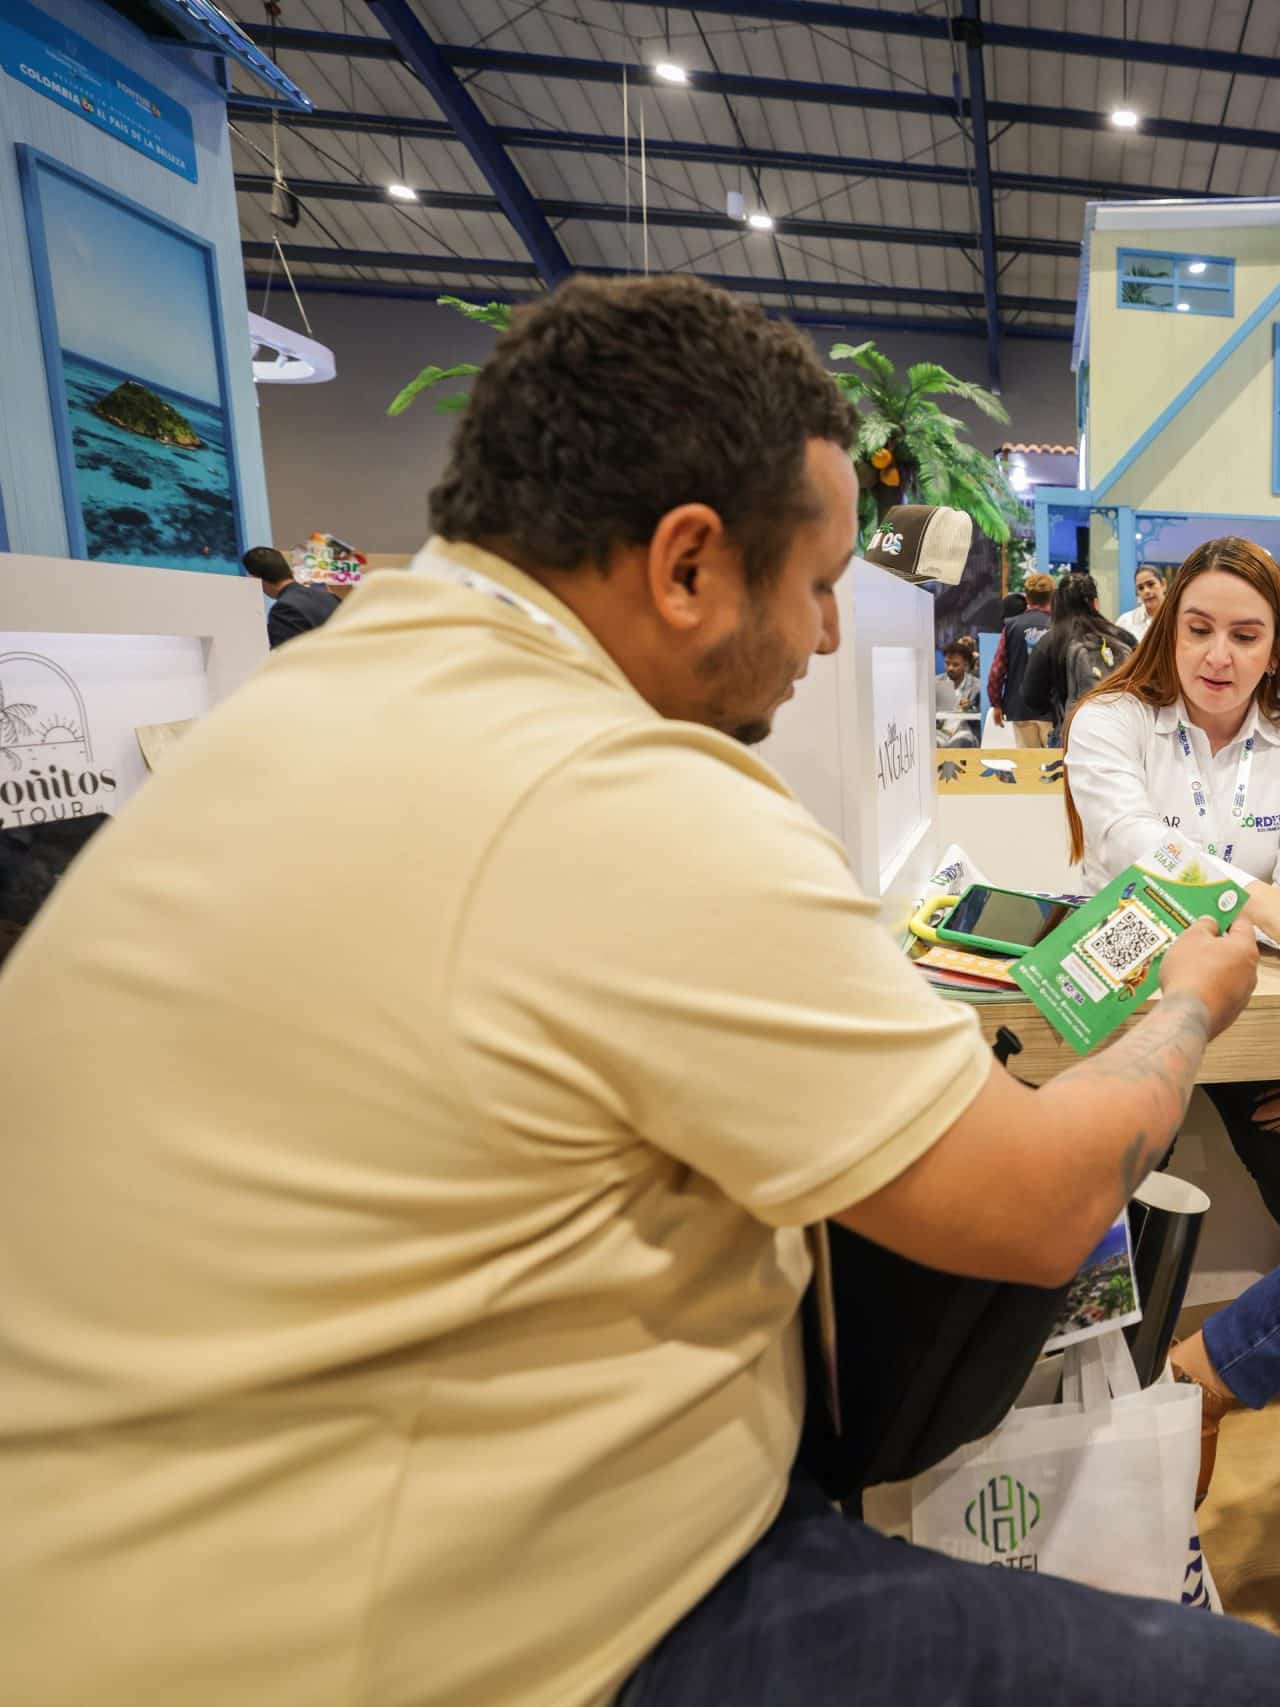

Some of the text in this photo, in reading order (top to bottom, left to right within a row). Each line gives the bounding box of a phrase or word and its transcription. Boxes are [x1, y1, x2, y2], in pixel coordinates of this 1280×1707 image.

[19, 63, 81, 105] COLOMBIA
[143, 137, 155, 152] LA
[303, 554, 360, 573] Cesar
[11, 801, 84, 826] TOUR
[1162, 816, 1181, 828] AR
